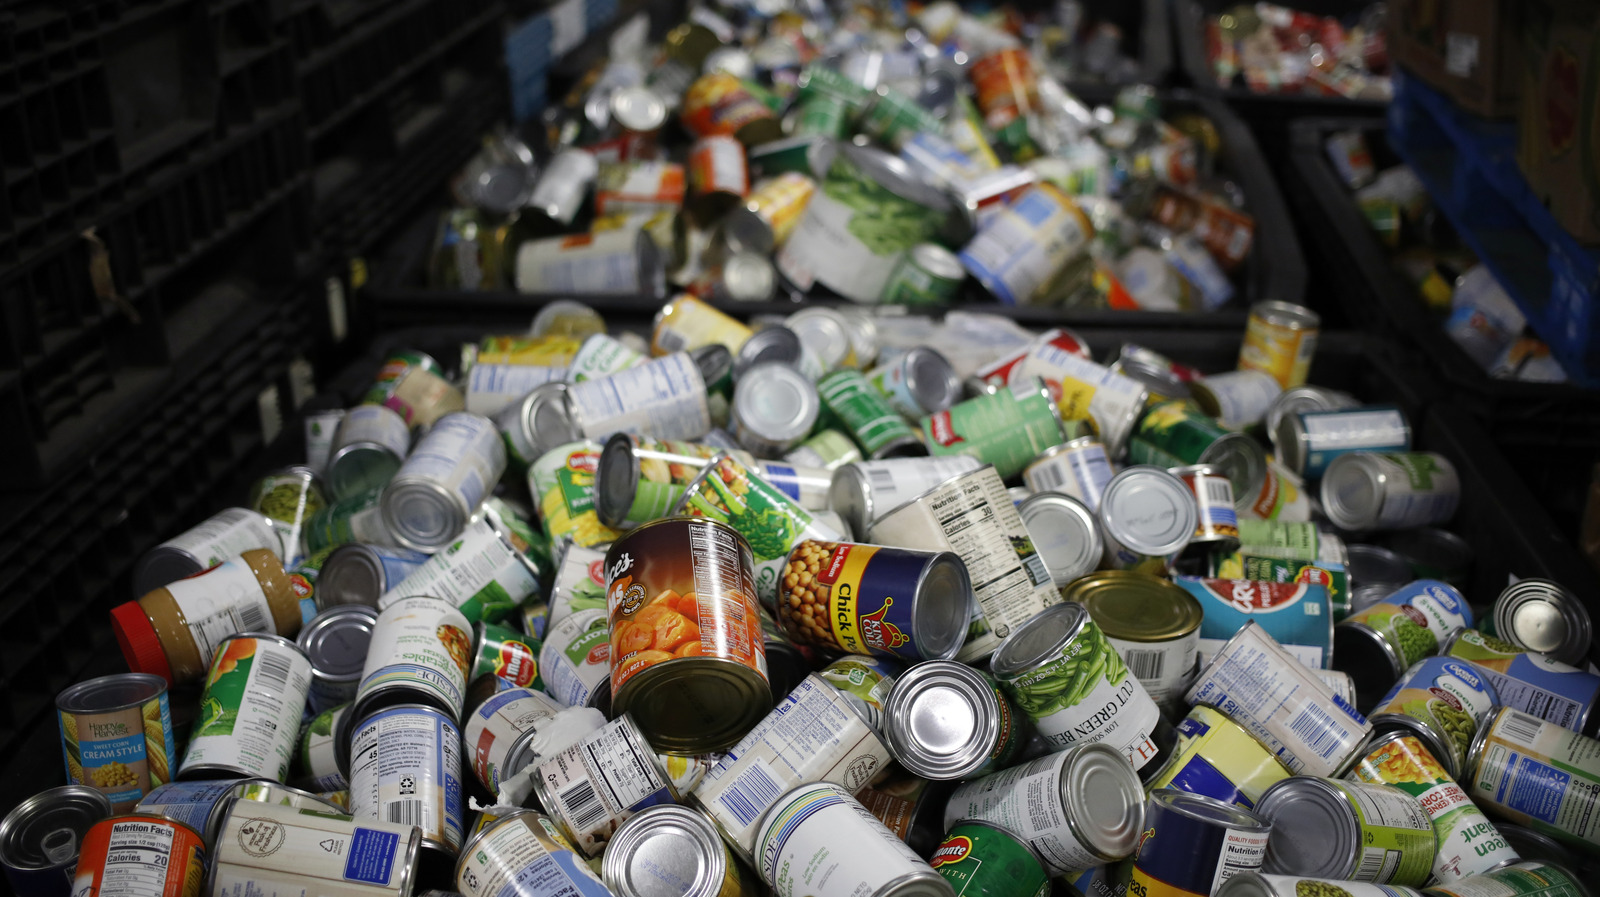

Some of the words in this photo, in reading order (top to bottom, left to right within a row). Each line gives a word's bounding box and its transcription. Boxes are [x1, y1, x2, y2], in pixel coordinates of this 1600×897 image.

[932, 492, 962, 511] Nutrition
[964, 485, 980, 496] Facts
[982, 506, 993, 516] 30
[945, 519, 970, 534] Calories
[840, 546, 849, 555] Low
[828, 556, 844, 577] Sodium
[837, 583, 851, 631] Chick
[862, 618, 877, 647] COLE
[871, 620, 885, 648] KING
[843, 635, 857, 650] Pe
[1070, 642, 1083, 653] NET
[1059, 653, 1071, 665] WT
[401, 652, 458, 681] Vegetables
[628, 661, 640, 671] 822
[1045, 661, 1061, 677] 14.5
[1036, 672, 1046, 682] OZ
[800, 681, 812, 692] acts
[1119, 679, 1134, 706] CUT
[1196, 681, 1215, 700] Facts
[780, 703, 791, 713] 20
[1224, 700, 1236, 713] 30
[1074, 702, 1119, 739] GREEN
[1560, 703, 1576, 729] Nutritio
[89, 723, 117, 731] Happy
[94, 728, 129, 738] Harvest
[361, 725, 376, 737] Facts
[1105, 720, 1119, 733] LOW
[83, 751, 115, 759] CREAM
[116, 744, 142, 756] STYLE
[368, 750, 377, 759] 45
[630, 757, 638, 767] Total
[611, 768, 622, 782] Protein
[1427, 796, 1451, 815] KERNE
[113, 824, 148, 832] Nutrition
[150, 825, 172, 838] Facts
[1227, 835, 1247, 843] QUALITY
[1227, 844, 1258, 856] Nutrition
[108, 854, 140, 862] Calories
[154, 855, 168, 866] 20
[530, 859, 553, 874] Calories
[801, 867, 812, 879] Low
[809, 846, 826, 868] Sodium
[777, 859, 790, 890] Peas
[804, 873, 815, 887] Bajo
[813, 865, 820, 873] en
[817, 850, 830, 866] sodio
[939, 867, 967, 880] WITH
[541, 870, 560, 882] Serving
[532, 880, 543, 889] size
[550, 884, 574, 897] Fact
[1129, 875, 1147, 896] eas
